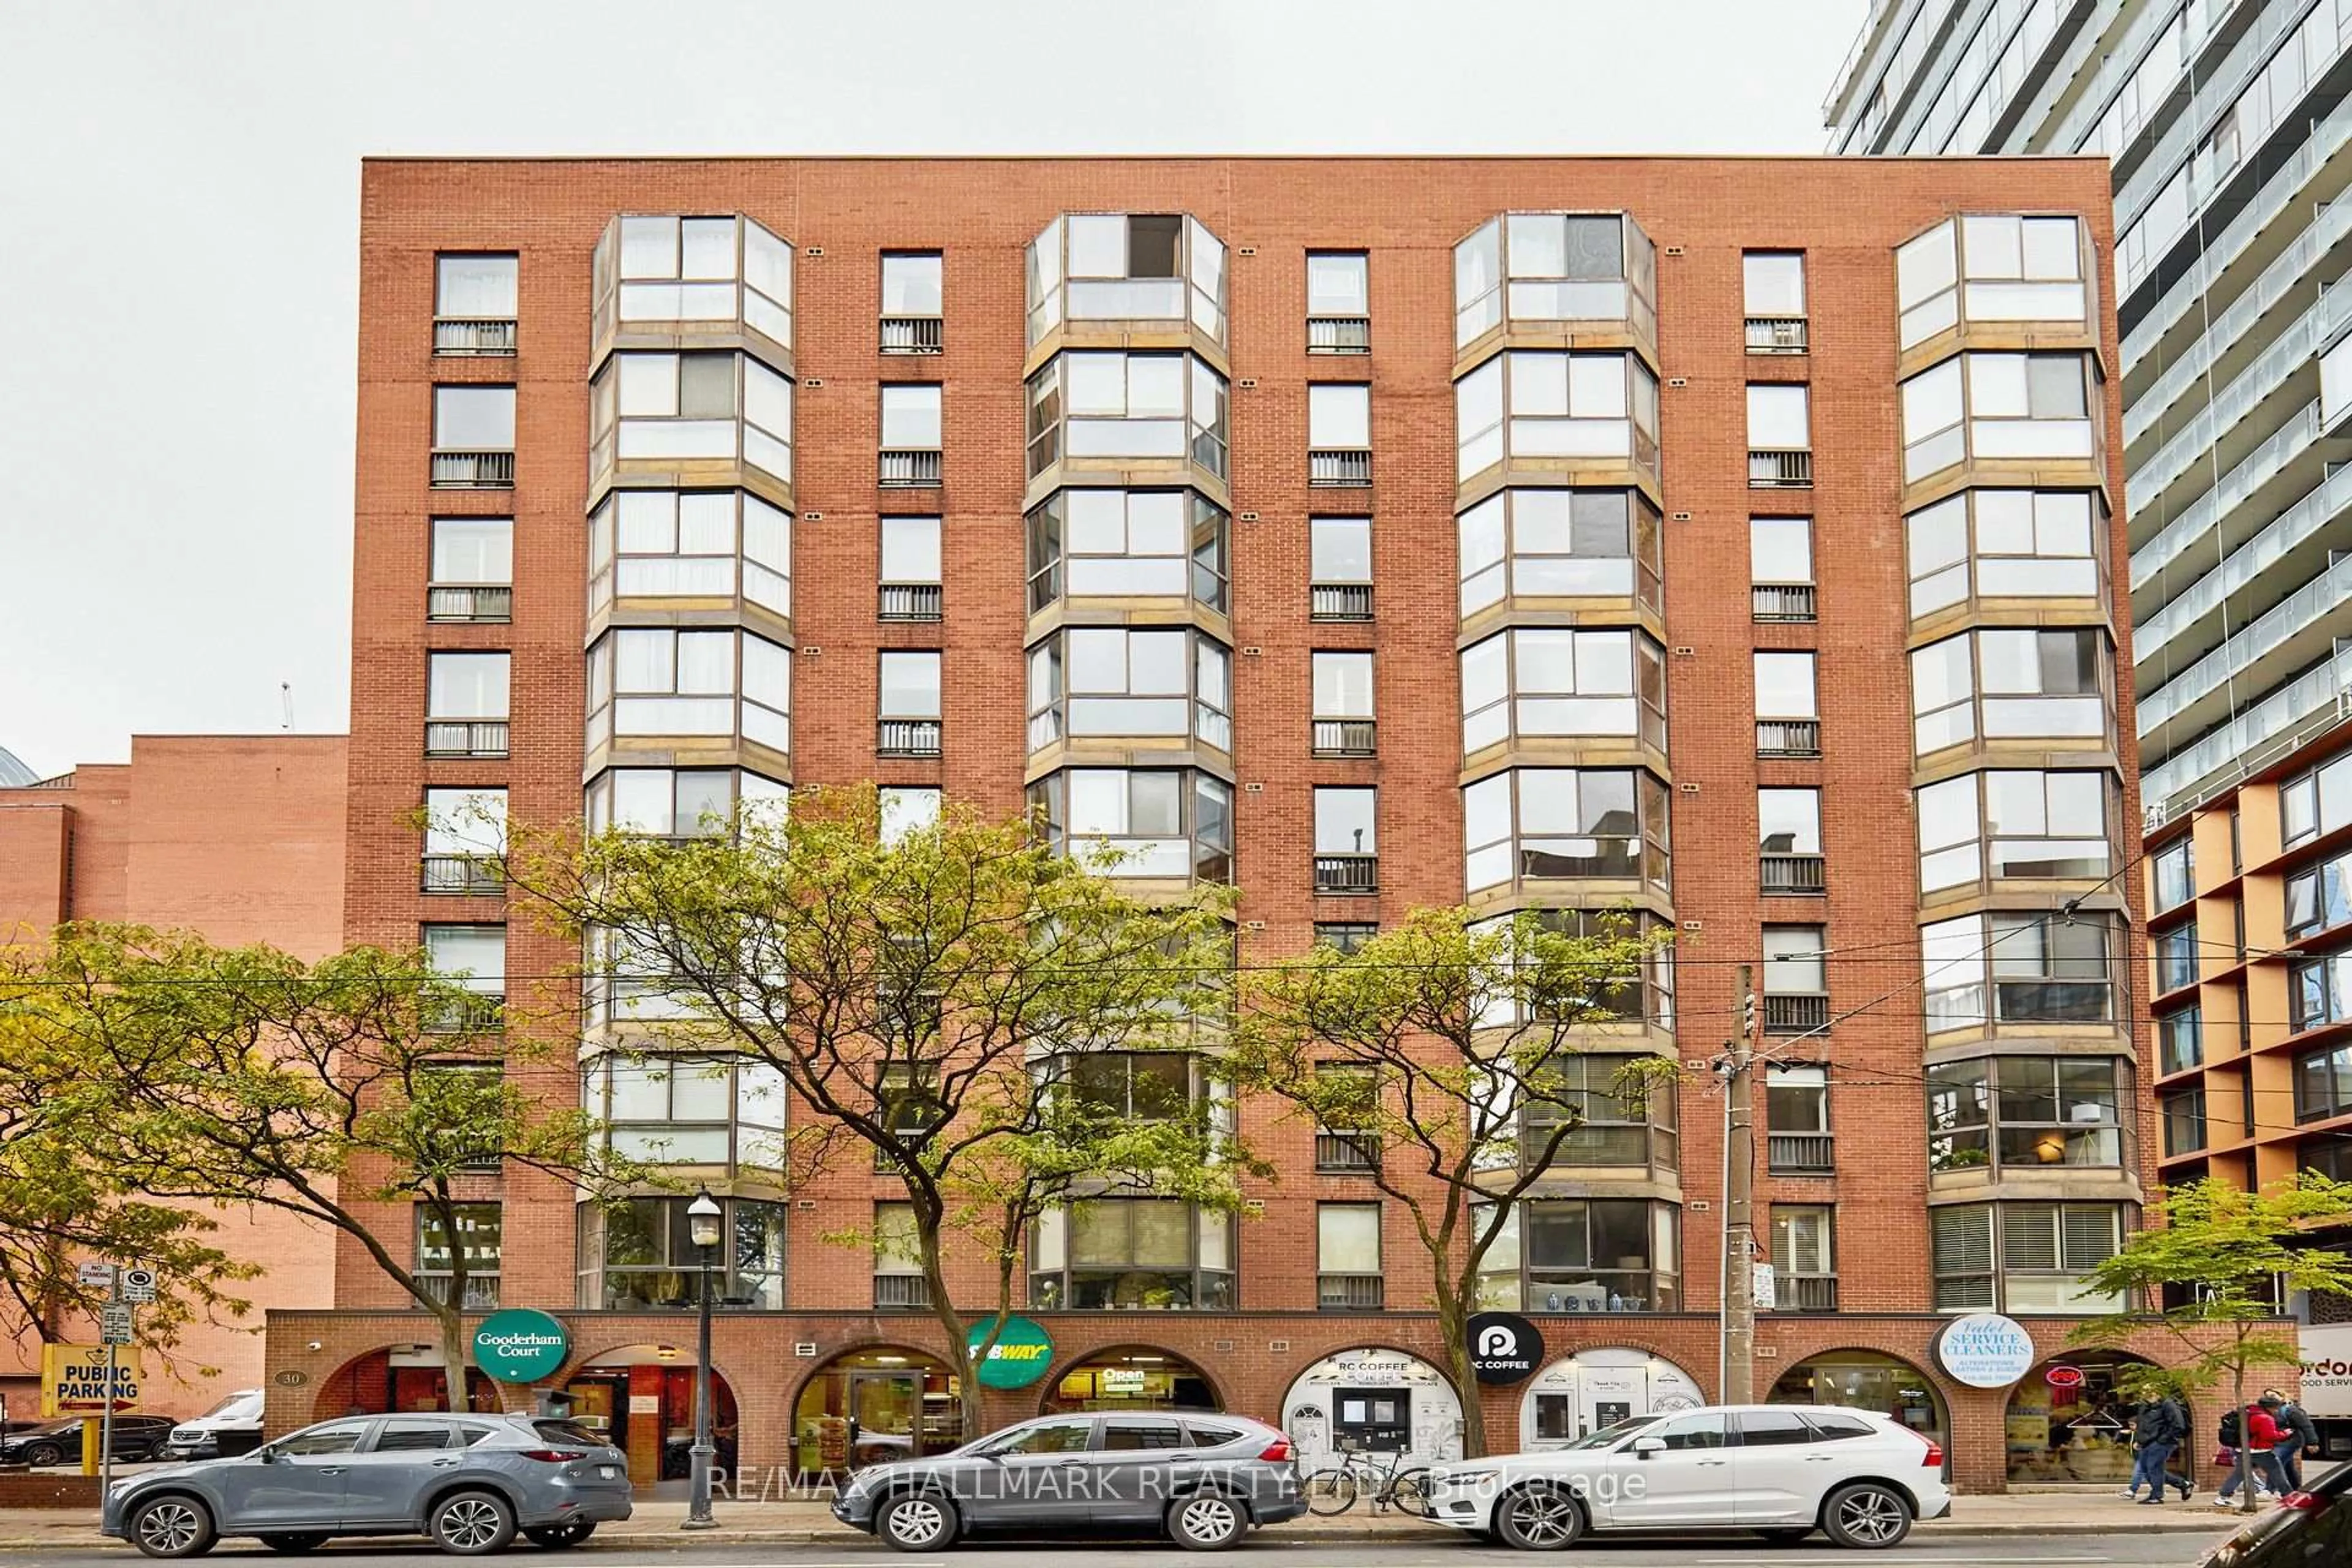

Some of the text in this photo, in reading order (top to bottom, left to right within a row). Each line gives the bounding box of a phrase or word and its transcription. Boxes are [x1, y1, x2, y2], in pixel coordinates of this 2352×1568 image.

[477, 1333, 562, 1344] Gooderham
[1951, 1333, 2020, 1344] SERVICE
[497, 1345, 540, 1357] Court
[1944, 1344, 2029, 1355] CLEANERS
[284, 1374, 300, 1384] 30
[1103, 1368, 1145, 1382] Open
[58, 1383, 138, 1398] PARKNG
